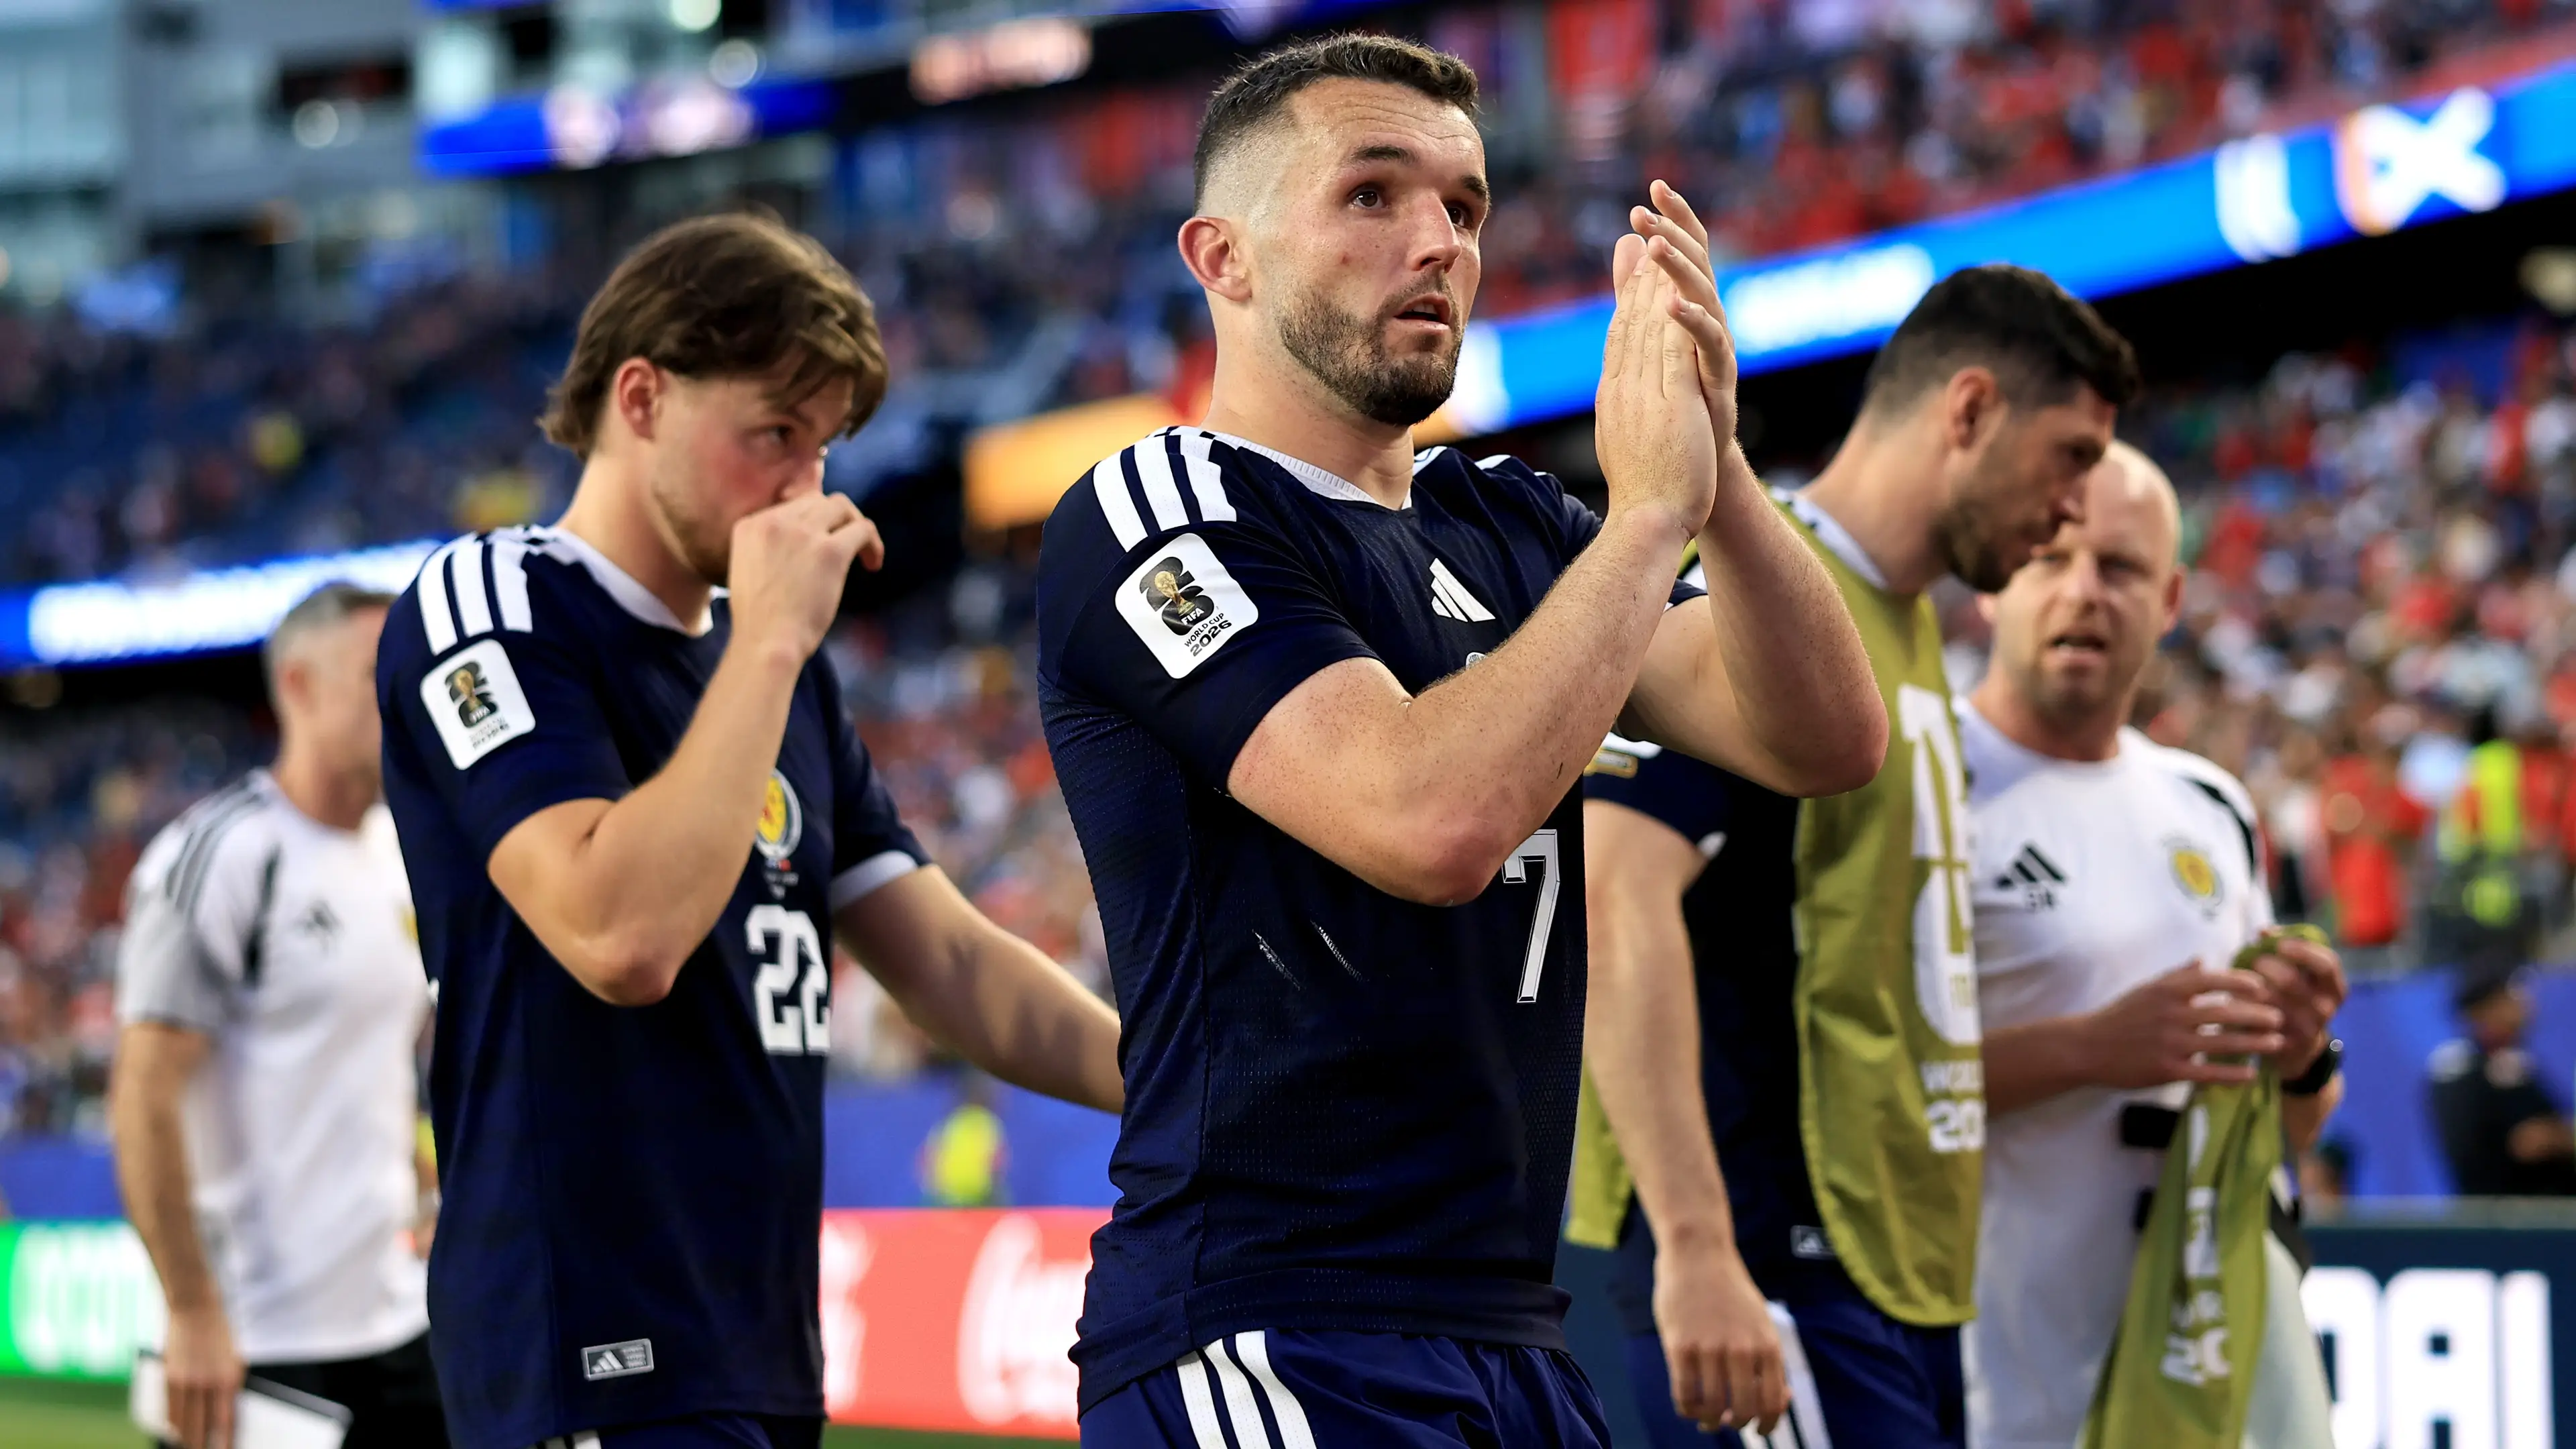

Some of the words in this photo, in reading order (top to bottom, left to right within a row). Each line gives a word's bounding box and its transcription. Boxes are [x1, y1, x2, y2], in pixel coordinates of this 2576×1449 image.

[1181, 607, 1205, 626] FIFA
[1184, 623, 1209, 647] WORLD
[1208, 612, 1224, 625] CUP
[1190, 620, 1232, 657] 2026
[1501, 828, 1561, 1004] 7
[745, 903, 831, 1055] 22
